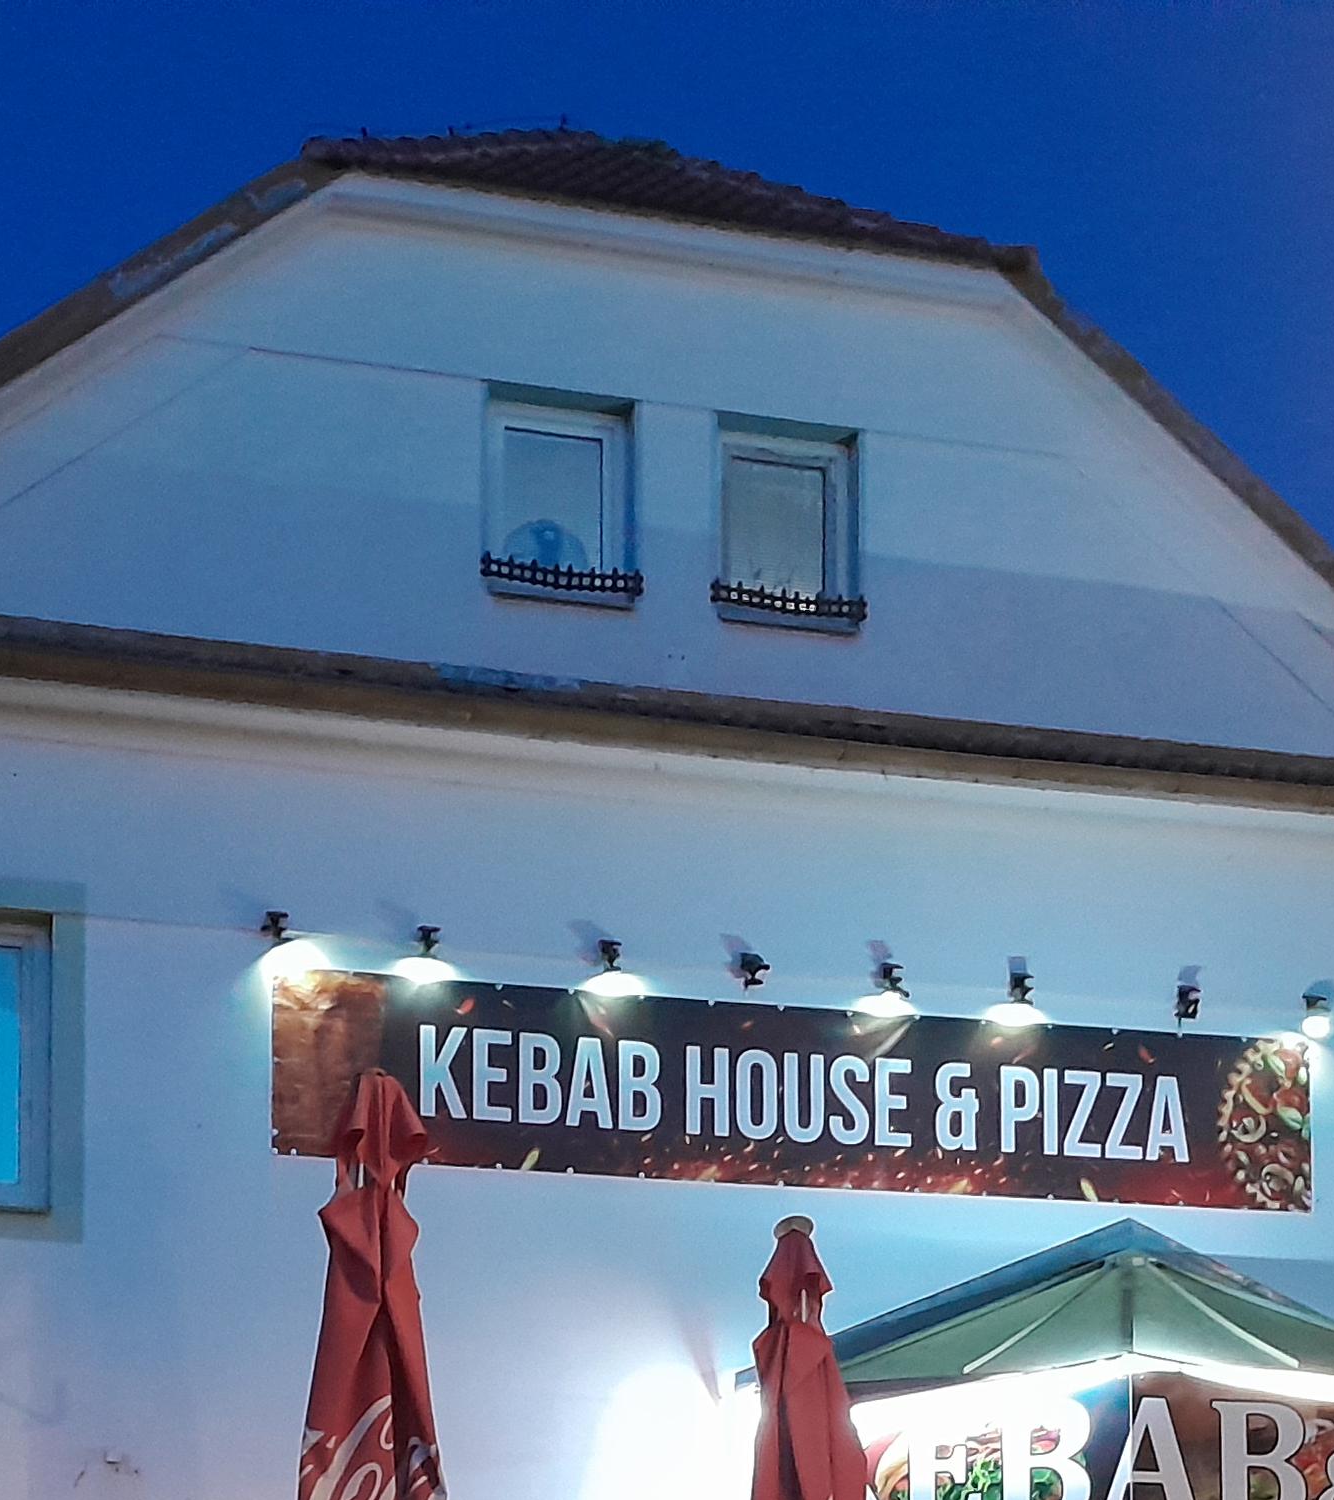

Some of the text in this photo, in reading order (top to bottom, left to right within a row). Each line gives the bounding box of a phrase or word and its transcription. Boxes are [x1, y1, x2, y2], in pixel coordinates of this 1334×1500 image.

[419, 1023, 1191, 1163] KEBAB HOUSE & PIZZA
